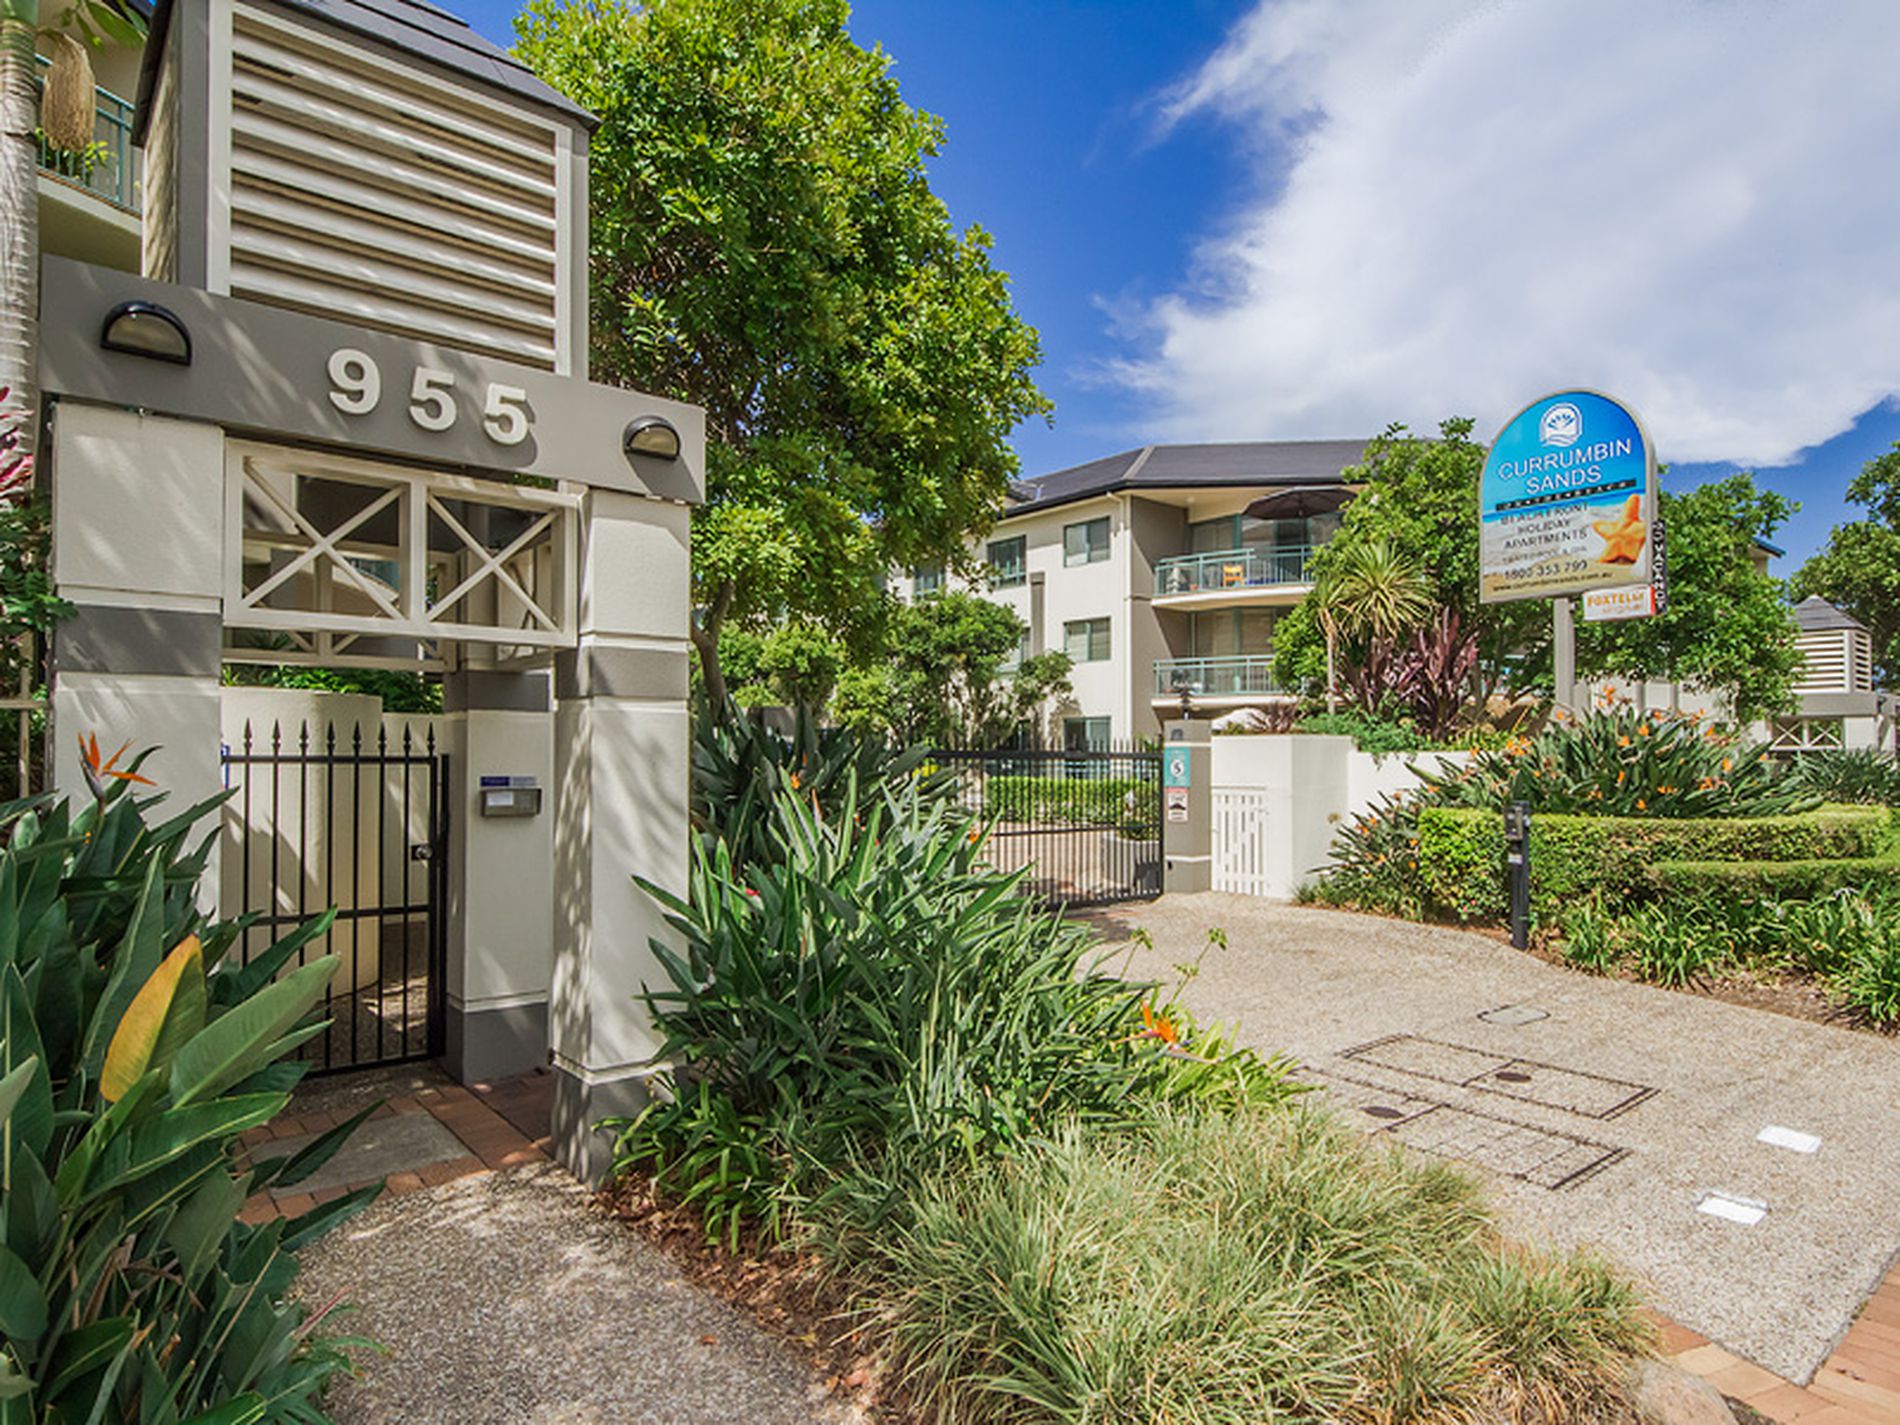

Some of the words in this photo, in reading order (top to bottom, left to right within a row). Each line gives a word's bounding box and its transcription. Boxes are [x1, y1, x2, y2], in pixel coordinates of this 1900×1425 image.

[327, 348, 528, 446] 955
[1498, 437, 1632, 480] CURRUMBIN
[1526, 465, 1602, 495] SANDS
[1517, 517, 1572, 534] HOLIDAY
[1504, 528, 1588, 549] APARTMENTS
[1504, 567, 1533, 581] 1800
[1652, 544, 1666, 610] VACANCY
[1587, 592, 1631, 608] FOXTEL
